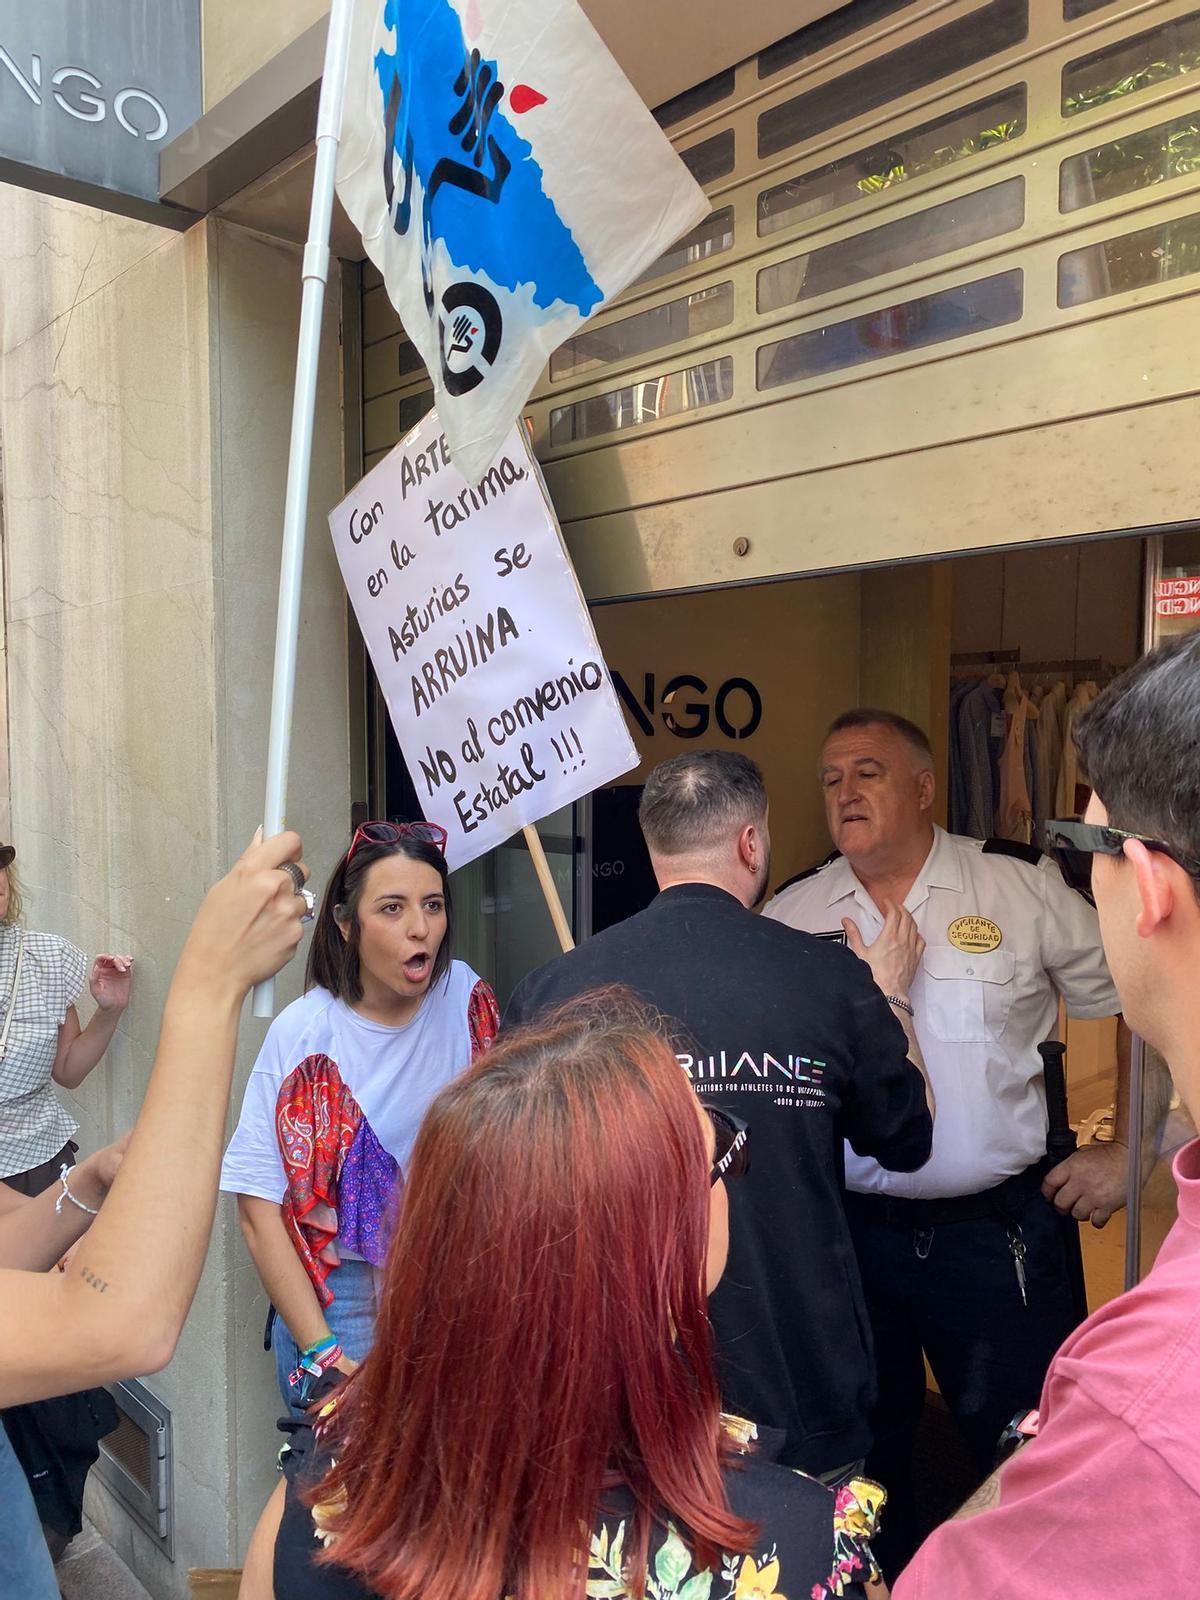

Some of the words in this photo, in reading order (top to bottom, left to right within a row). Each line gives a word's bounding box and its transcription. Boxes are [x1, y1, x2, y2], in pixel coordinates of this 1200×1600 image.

[348, 500, 384, 545] Con
[367, 568, 389, 597] en
[391, 539, 417, 570] la
[424, 455, 530, 537] tarima,
[387, 572, 470, 663] Asturias
[493, 542, 532, 578] se
[460, 717, 486, 763] al
[487, 657, 603, 746] convenio
[609, 669, 762, 740] NGO
[452, 742, 546, 834] Estatal
[550, 726, 586, 776] !!!
[951, 931, 1000, 941] SEGURIDAD
[954, 918, 996, 933] VIGILANTE
[725, 1083, 739, 1093] FOR
[740, 1083, 774, 1094] ATHLETES
[776, 1084, 784, 1093] TO
